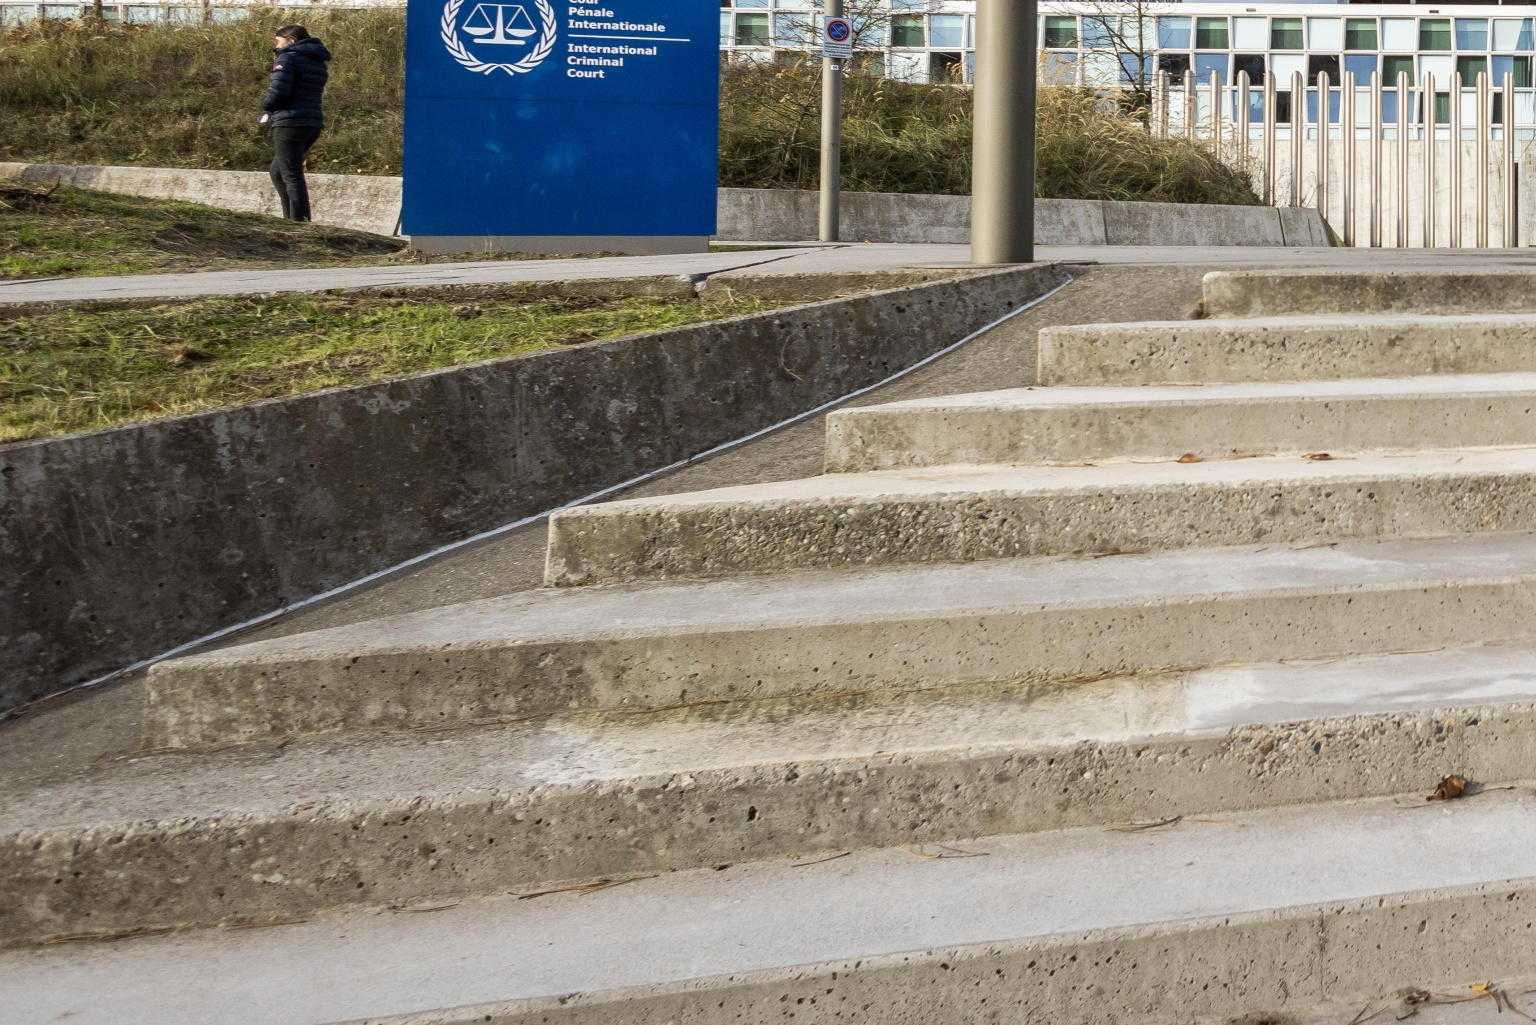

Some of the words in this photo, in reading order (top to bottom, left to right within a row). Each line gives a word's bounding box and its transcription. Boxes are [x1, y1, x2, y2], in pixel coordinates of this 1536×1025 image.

[568, 7, 614, 17] Pénale
[568, 19, 666, 32] Internationale
[567, 43, 657, 56] International
[567, 56, 624, 66] Criminal
[567, 68, 605, 78] Court
